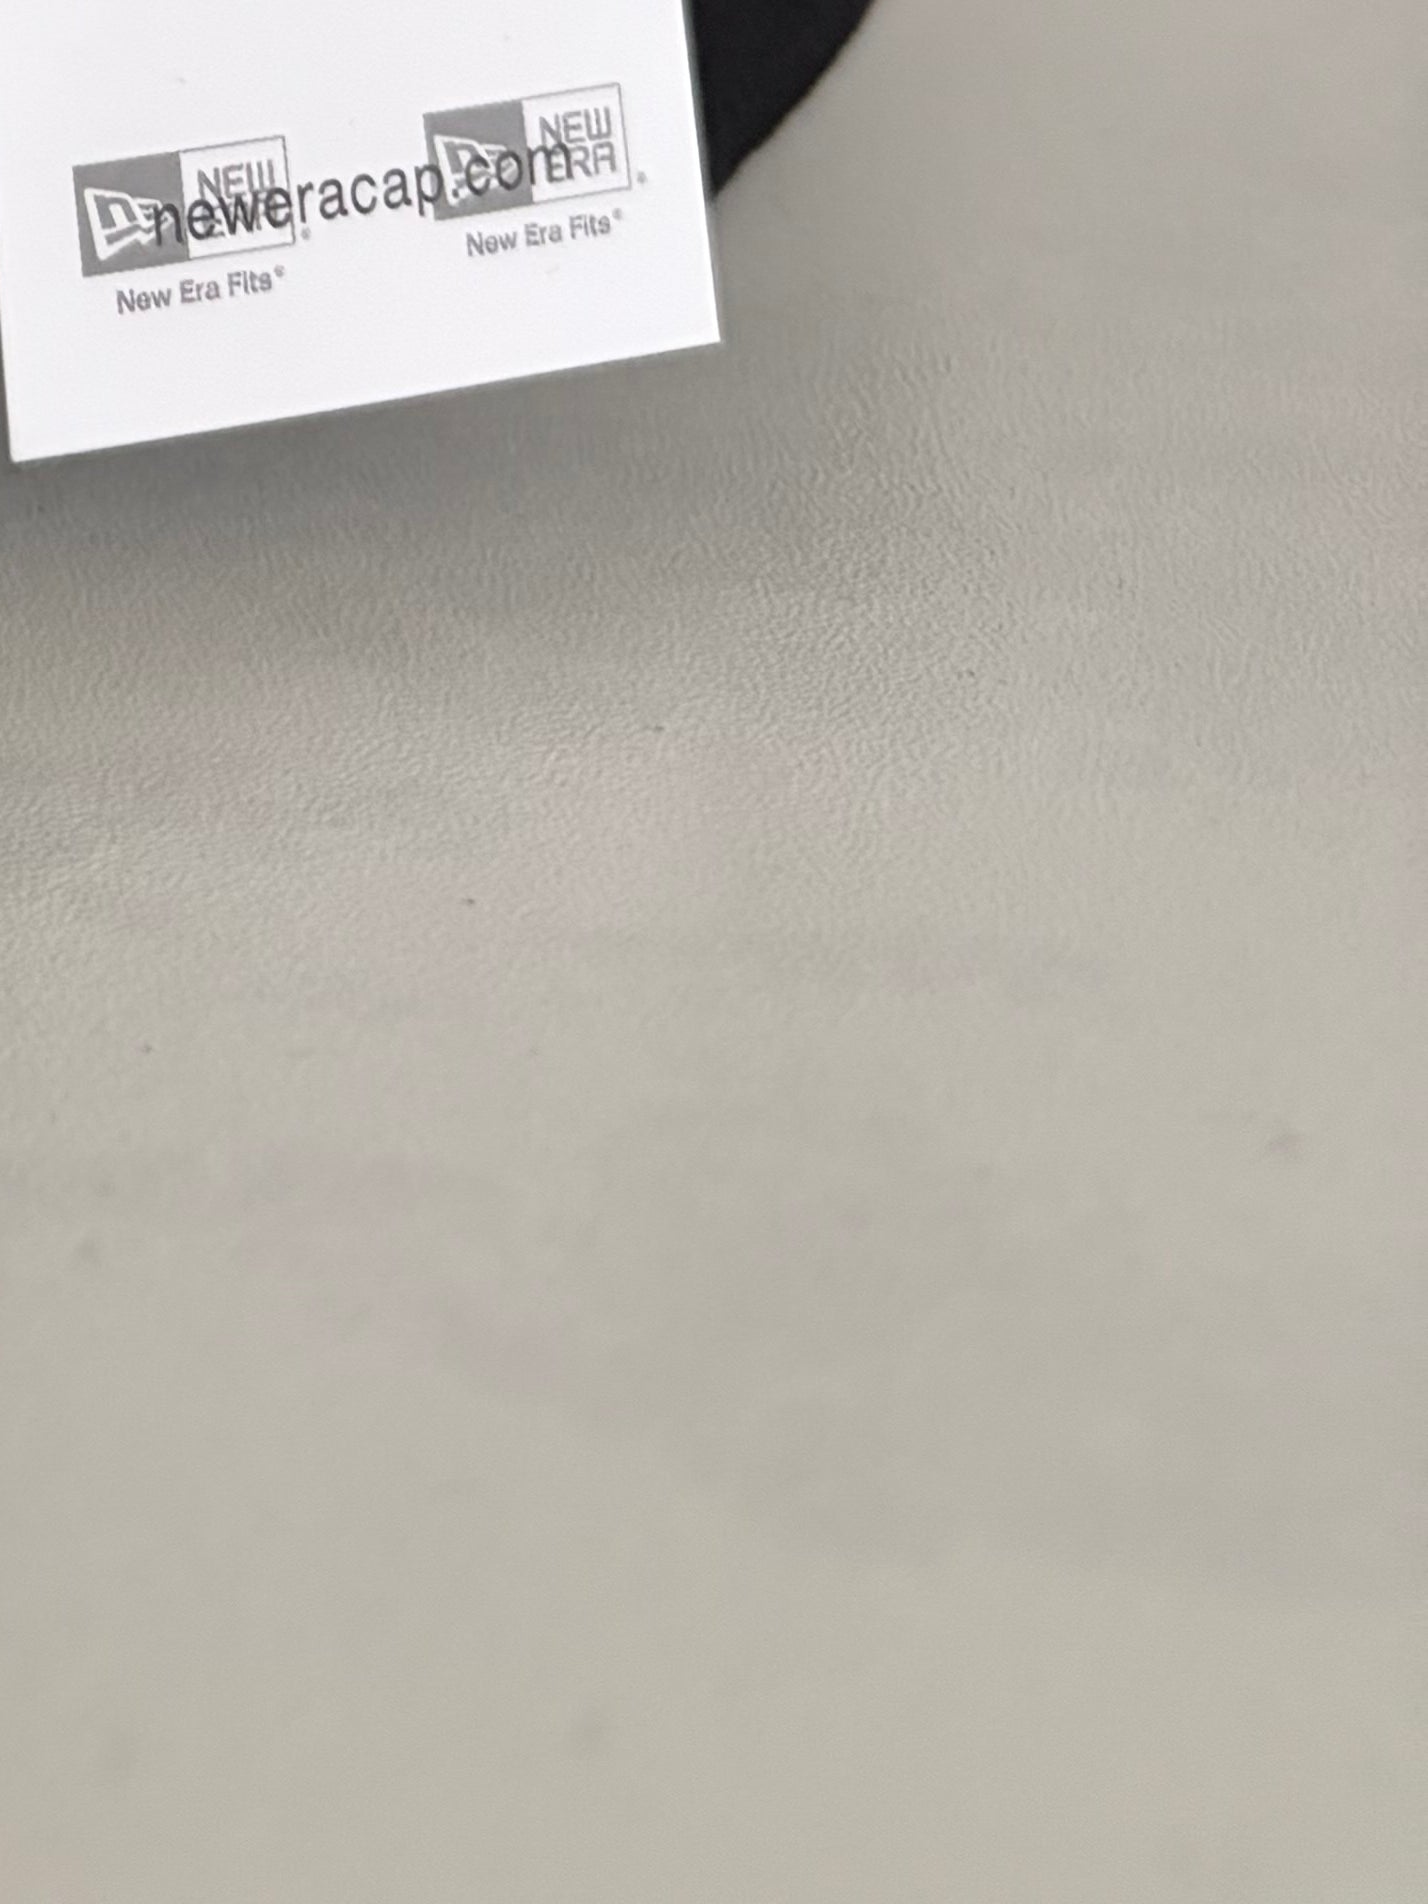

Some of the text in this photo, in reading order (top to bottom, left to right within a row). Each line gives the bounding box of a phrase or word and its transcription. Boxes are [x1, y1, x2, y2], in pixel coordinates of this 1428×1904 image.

[539, 106, 613, 145] NEW
[153, 141, 574, 246] neweracap.com
[466, 232, 518, 257] New
[524, 223, 562, 247] Era
[116, 288, 172, 314] New
[179, 279, 220, 303] Era
